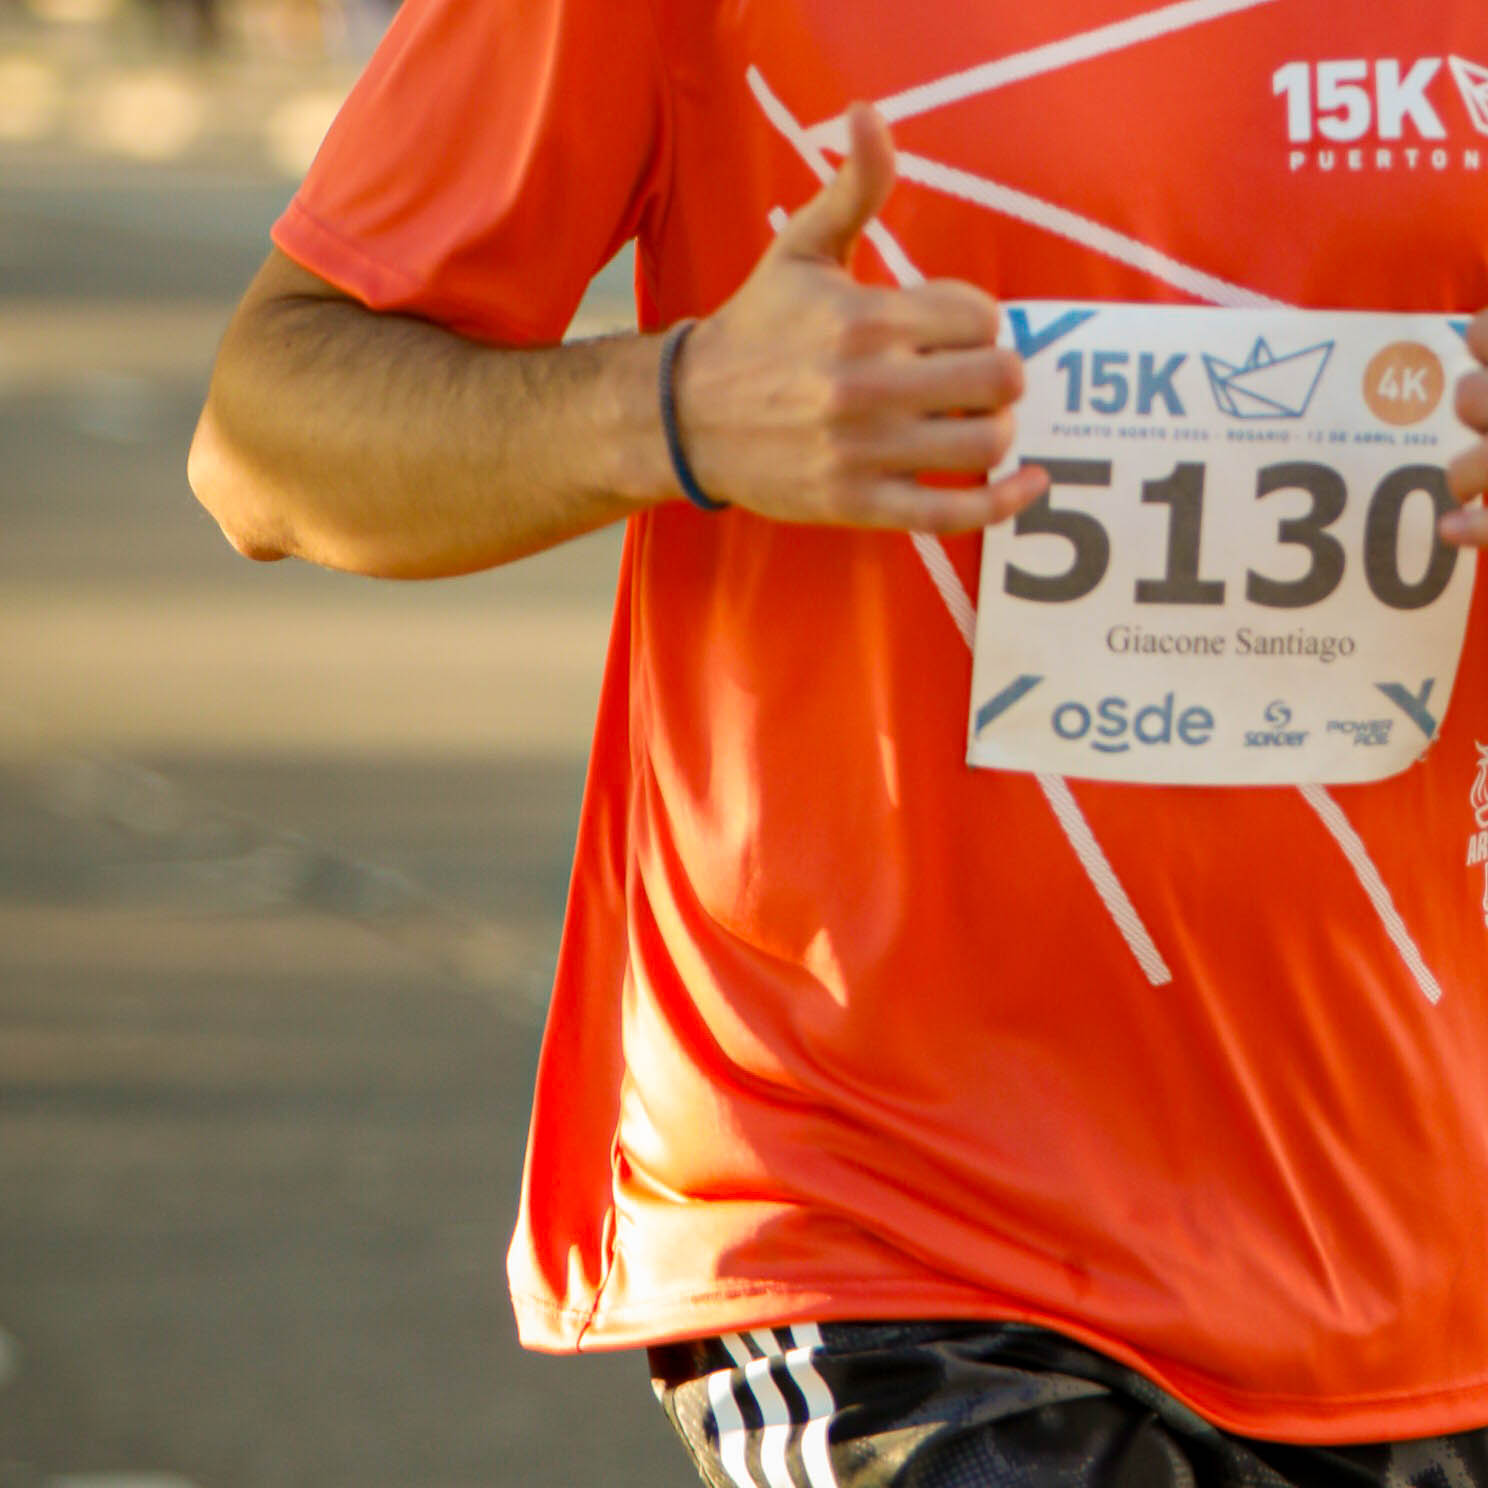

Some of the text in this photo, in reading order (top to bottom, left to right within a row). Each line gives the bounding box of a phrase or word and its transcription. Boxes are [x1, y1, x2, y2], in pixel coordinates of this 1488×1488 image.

[1272, 57, 1447, 142] 15K
[1289, 148, 1448, 172] PUERTO
[1055, 350, 1428, 417] 15K 4K
[1003, 456, 1460, 611] 5130
[1106, 625, 1356, 663] Giacone Santiago
[1051, 691, 1215, 747] osde
